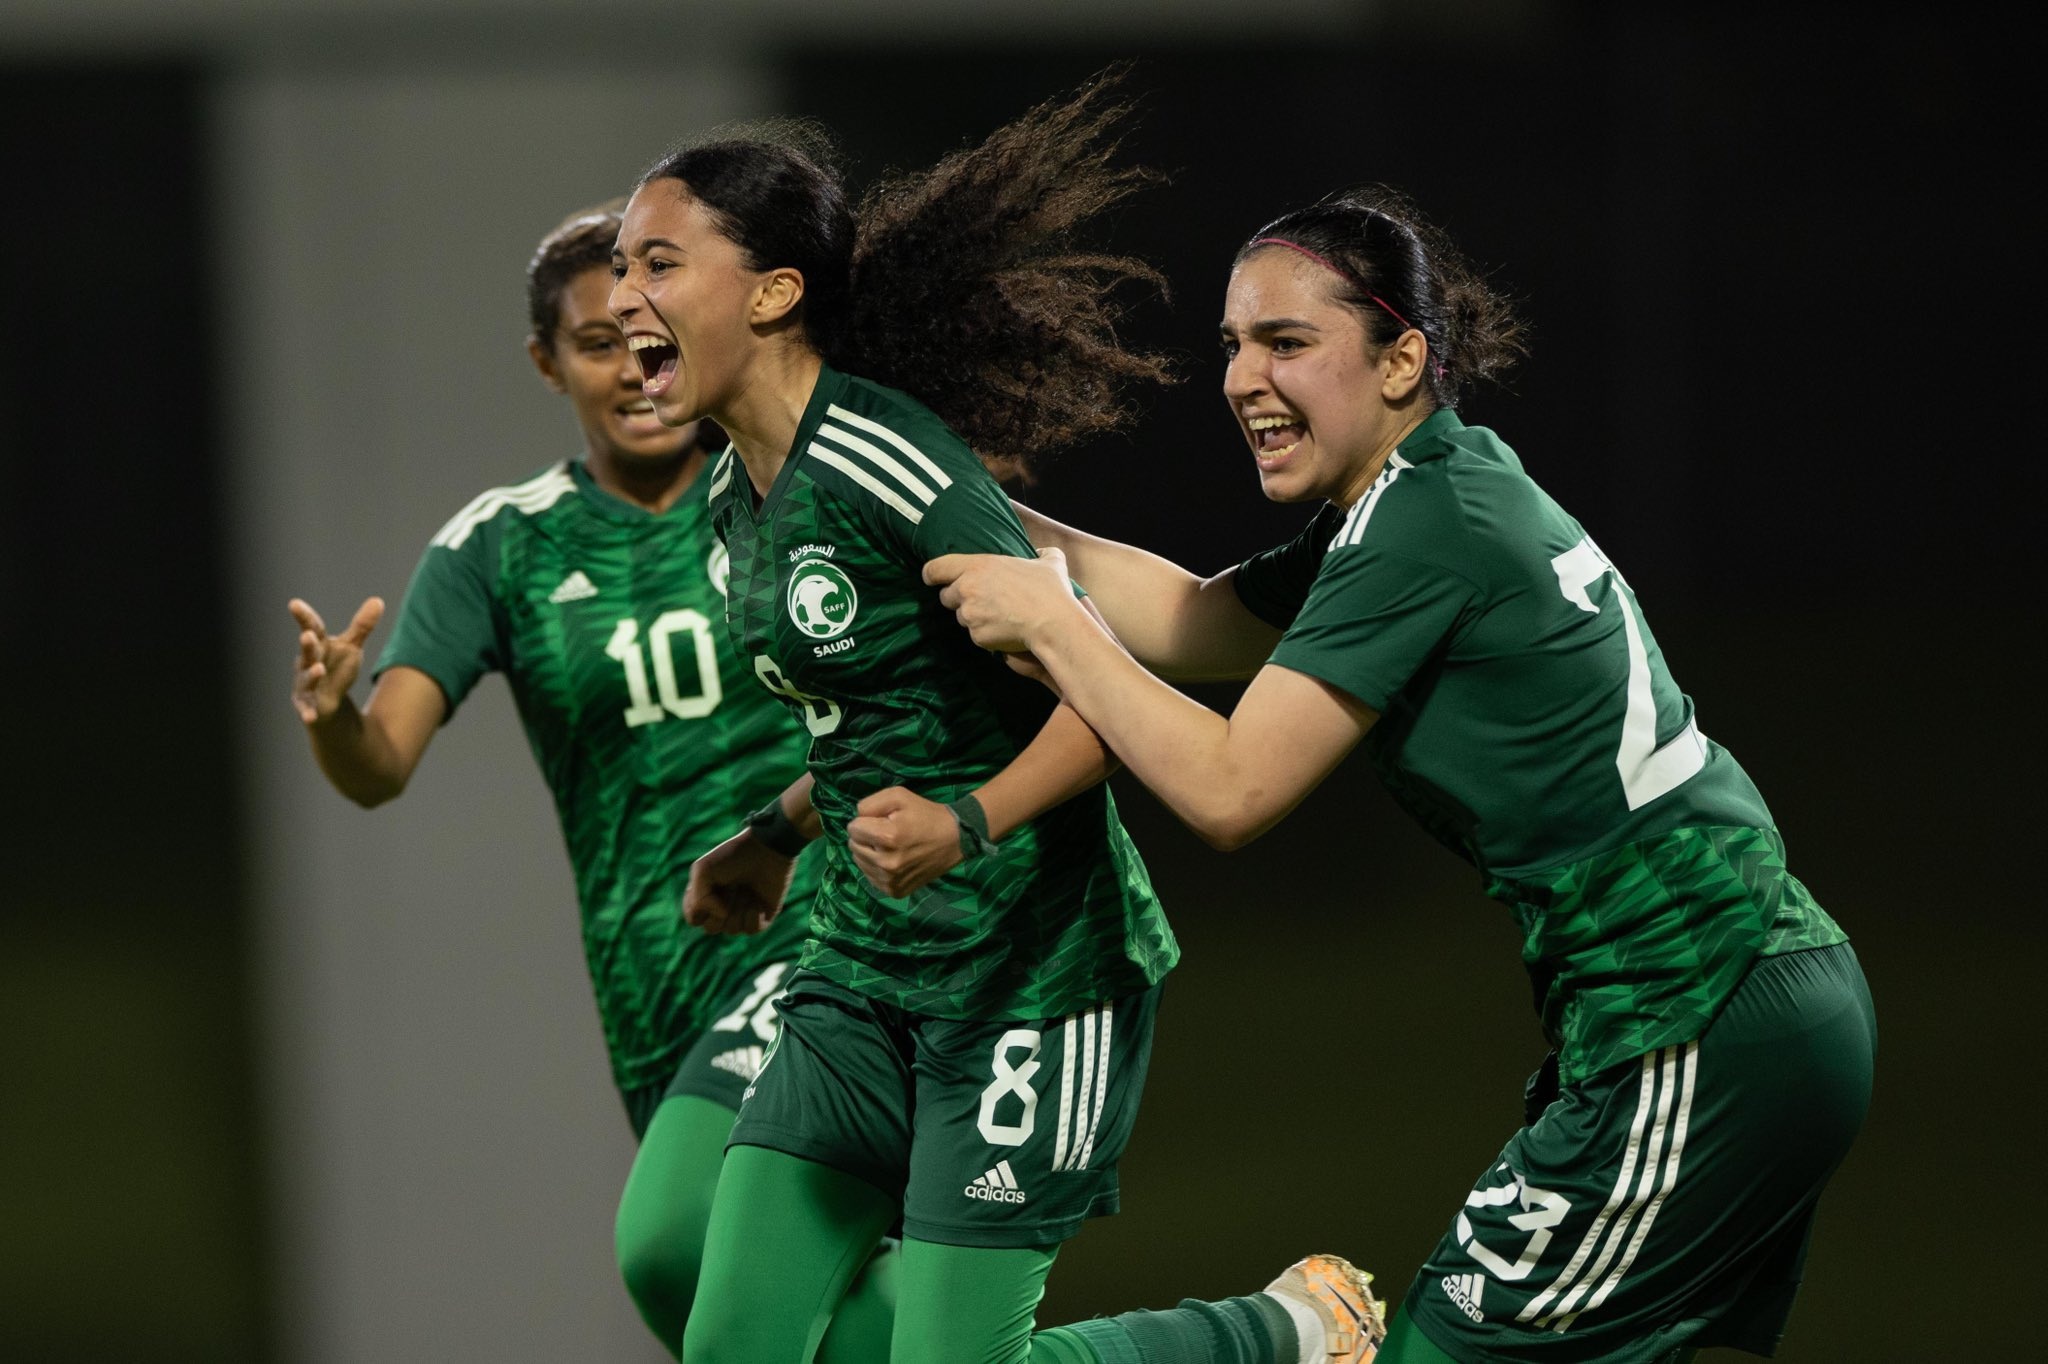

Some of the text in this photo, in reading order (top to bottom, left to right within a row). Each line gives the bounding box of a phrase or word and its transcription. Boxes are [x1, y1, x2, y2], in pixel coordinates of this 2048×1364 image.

[788, 543, 836, 563] السعودية
[823, 602, 846, 615] SAFF
[813, 637, 855, 658] SAUDI
[605, 608, 723, 728] 10
[754, 654, 842, 737] 8
[976, 1029, 1041, 1146] 8
[964, 1184, 1026, 1204] adidas
[1441, 1276, 1486, 1323] adidas
